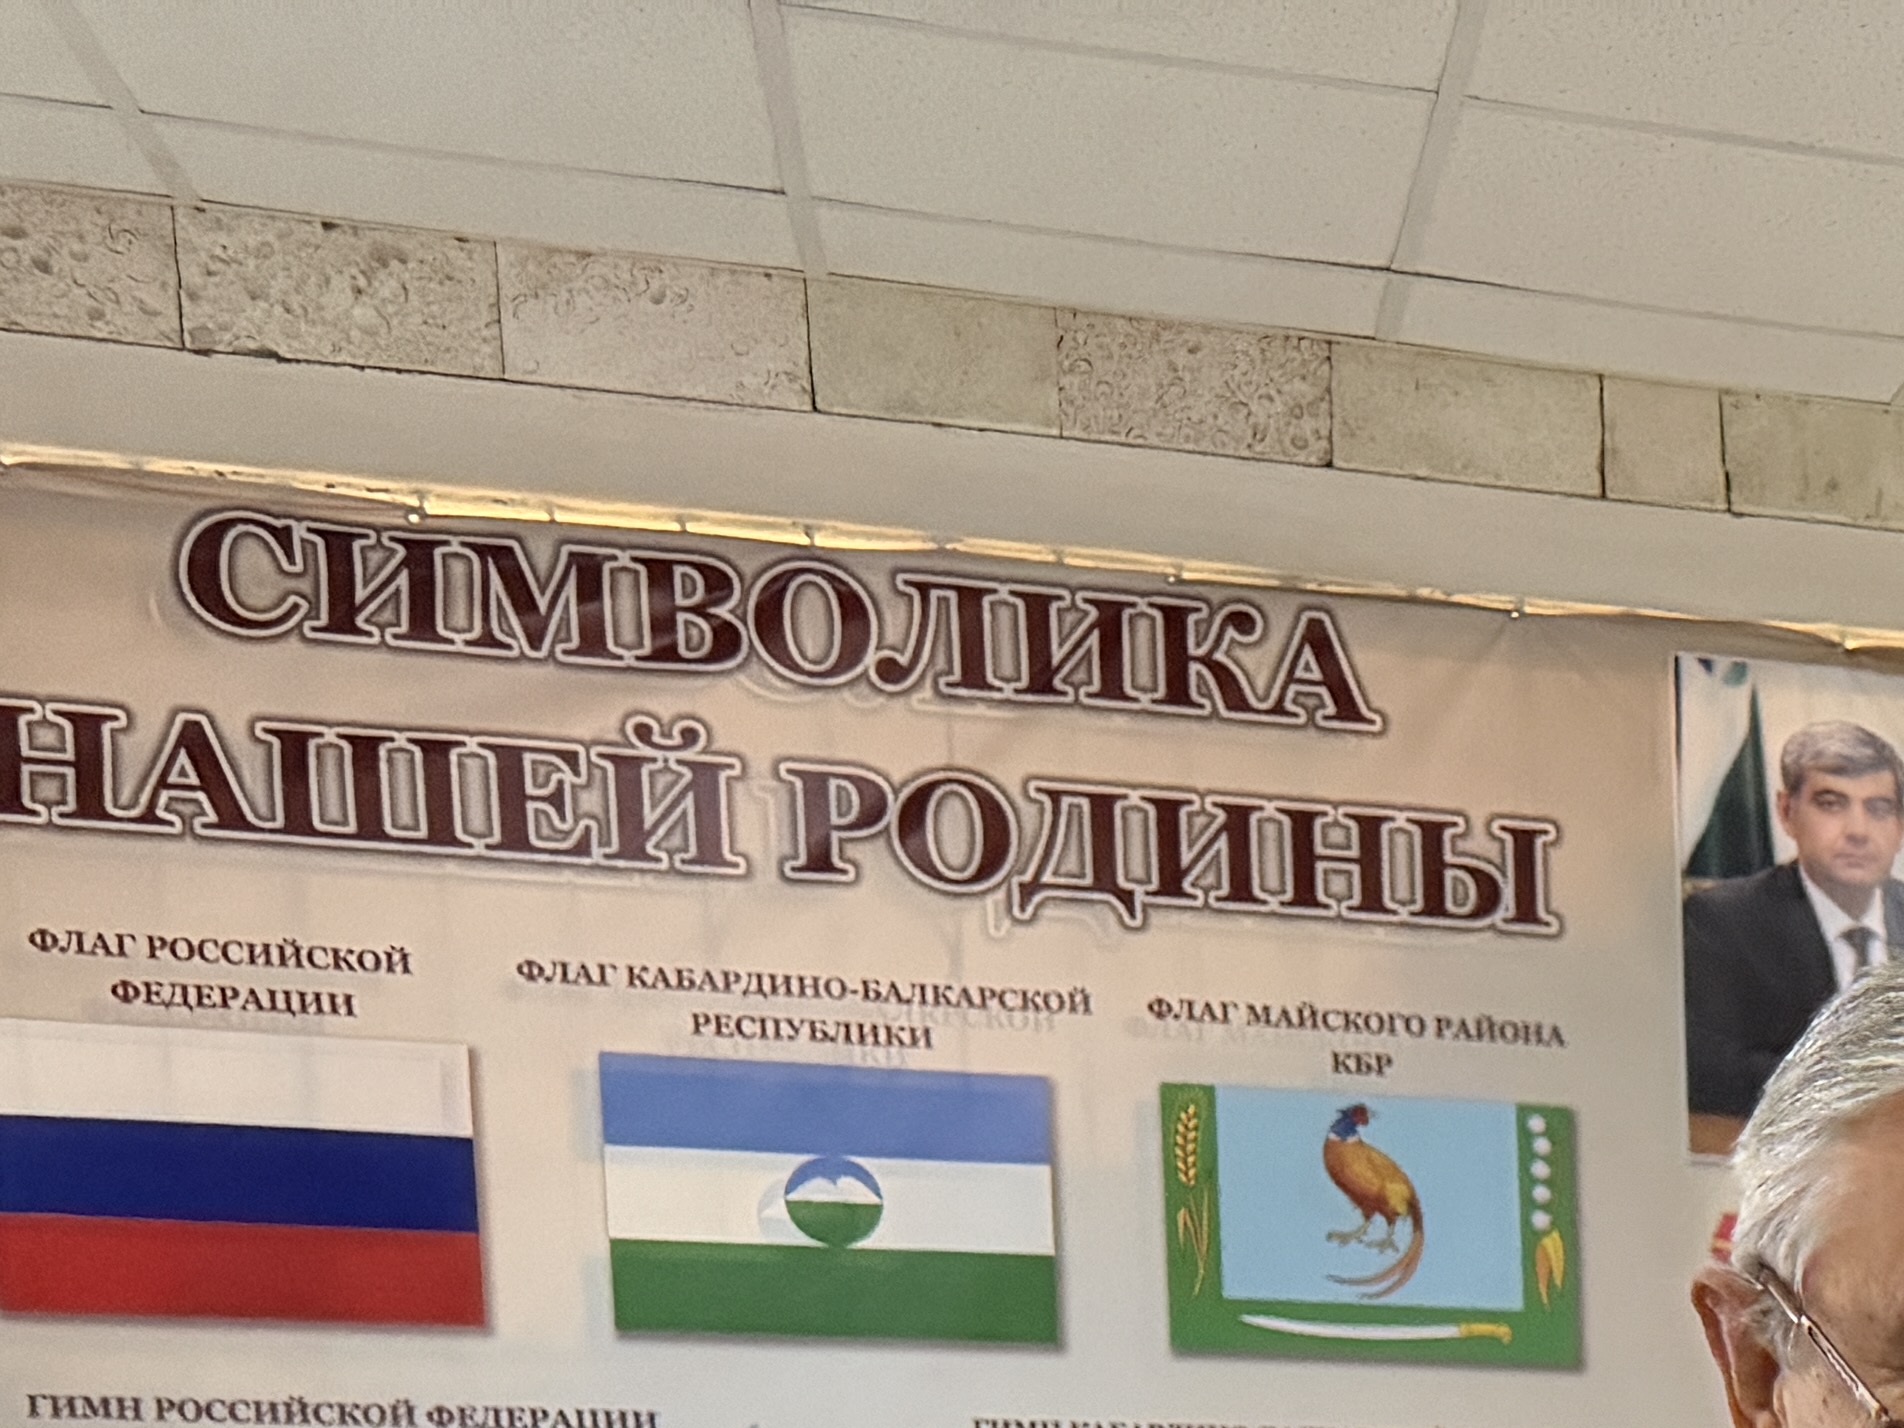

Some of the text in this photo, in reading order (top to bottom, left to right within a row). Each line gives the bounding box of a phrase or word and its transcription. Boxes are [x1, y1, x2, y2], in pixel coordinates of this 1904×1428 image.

[181, 511, 1384, 731] СИМВОЛИКА
[0, 699, 1559, 934] НАШЕЙ РОДИНЫ
[27, 927, 414, 976] ФЛАГ РОССИЙСКОЙ
[110, 979, 357, 1018] ФЕДЕРАЦИИ
[515, 958, 1093, 1016] ФЛАГ КАБАРДИНО-БАЛКАРСКОЙ
[691, 1011, 933, 1050] РЕСПУБЛИКИ
[1147, 997, 1567, 1049] ФЛАГ МАЙСКОГО РАЙОНА
[1331, 1050, 1394, 1078] КБР
[26, 1393, 145, 1422] ГИМН
[154, 1396, 416, 1428] РОССИЙСКОЙ
